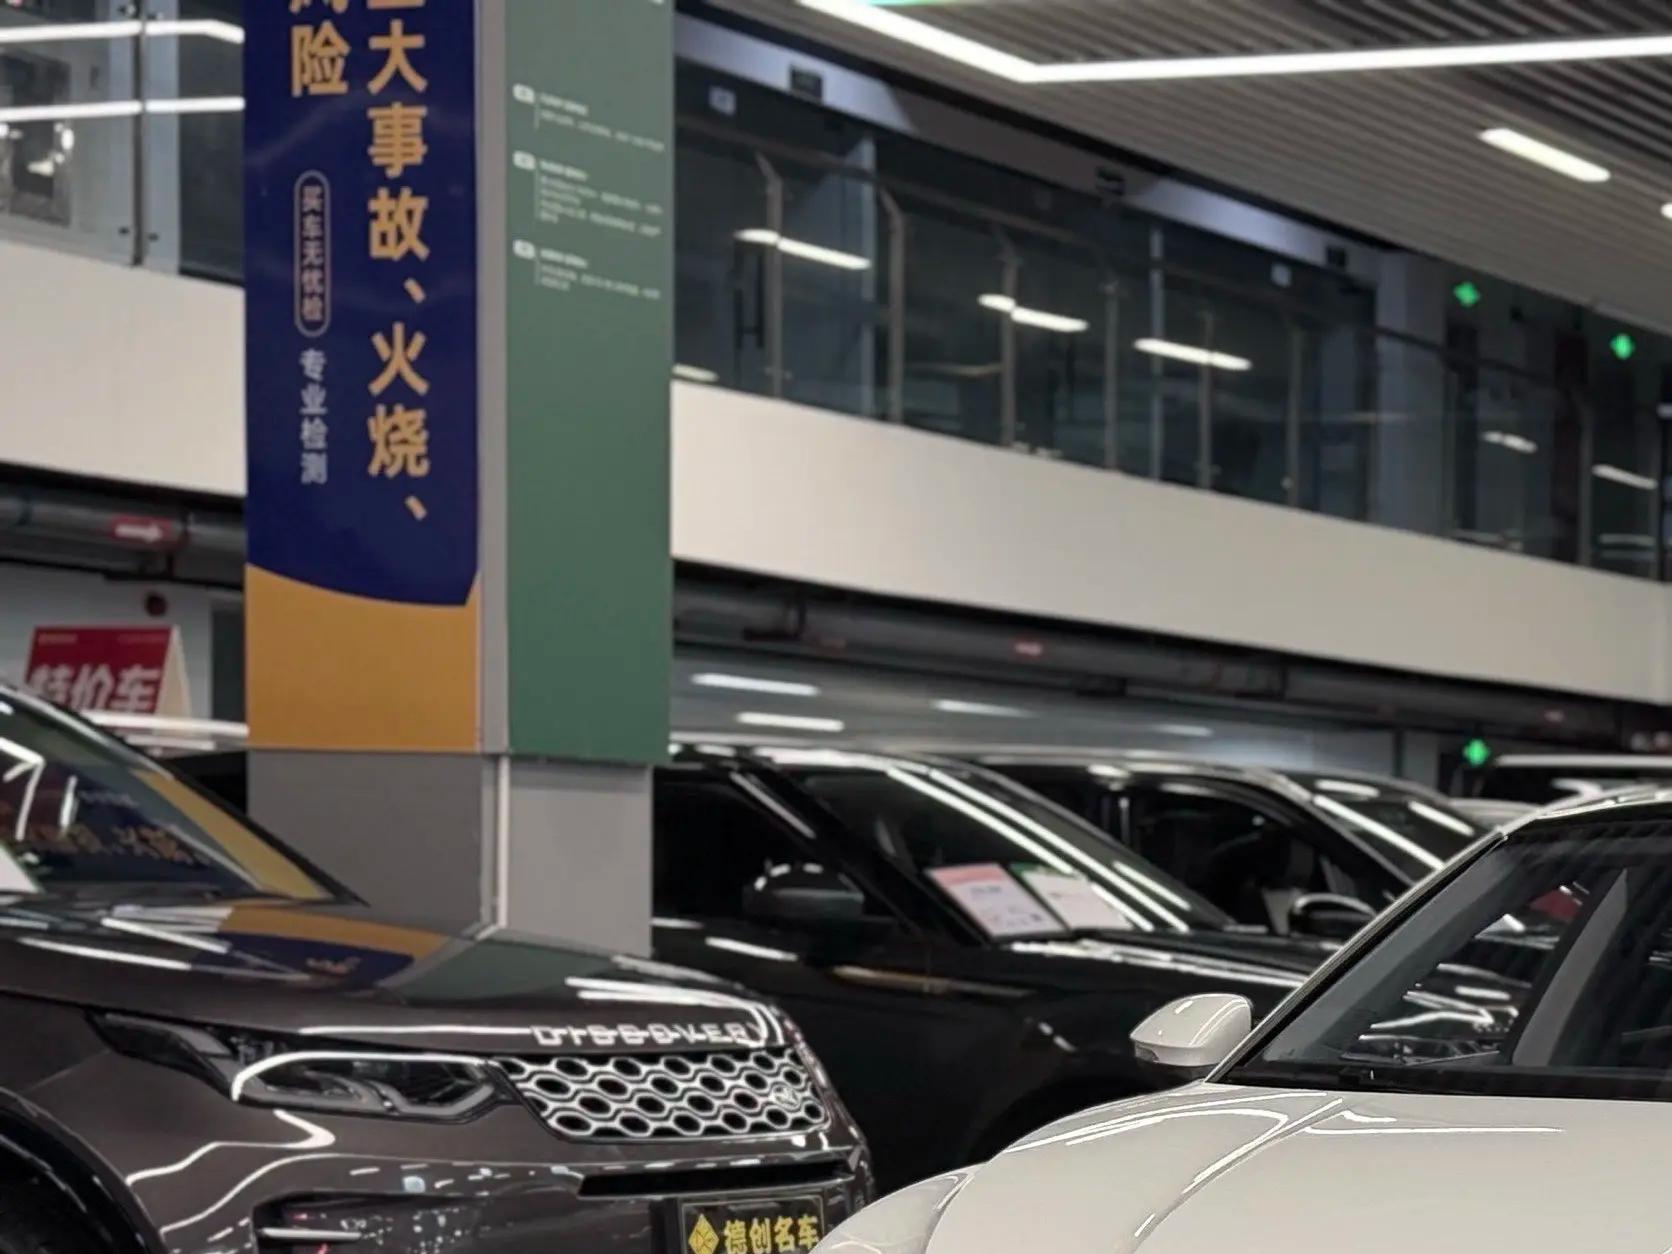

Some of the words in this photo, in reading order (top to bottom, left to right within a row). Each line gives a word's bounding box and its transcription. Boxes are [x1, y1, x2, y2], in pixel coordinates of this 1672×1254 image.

[289, 0, 351, 97] 险
[367, 0, 430, 521] 大事故、火烧、
